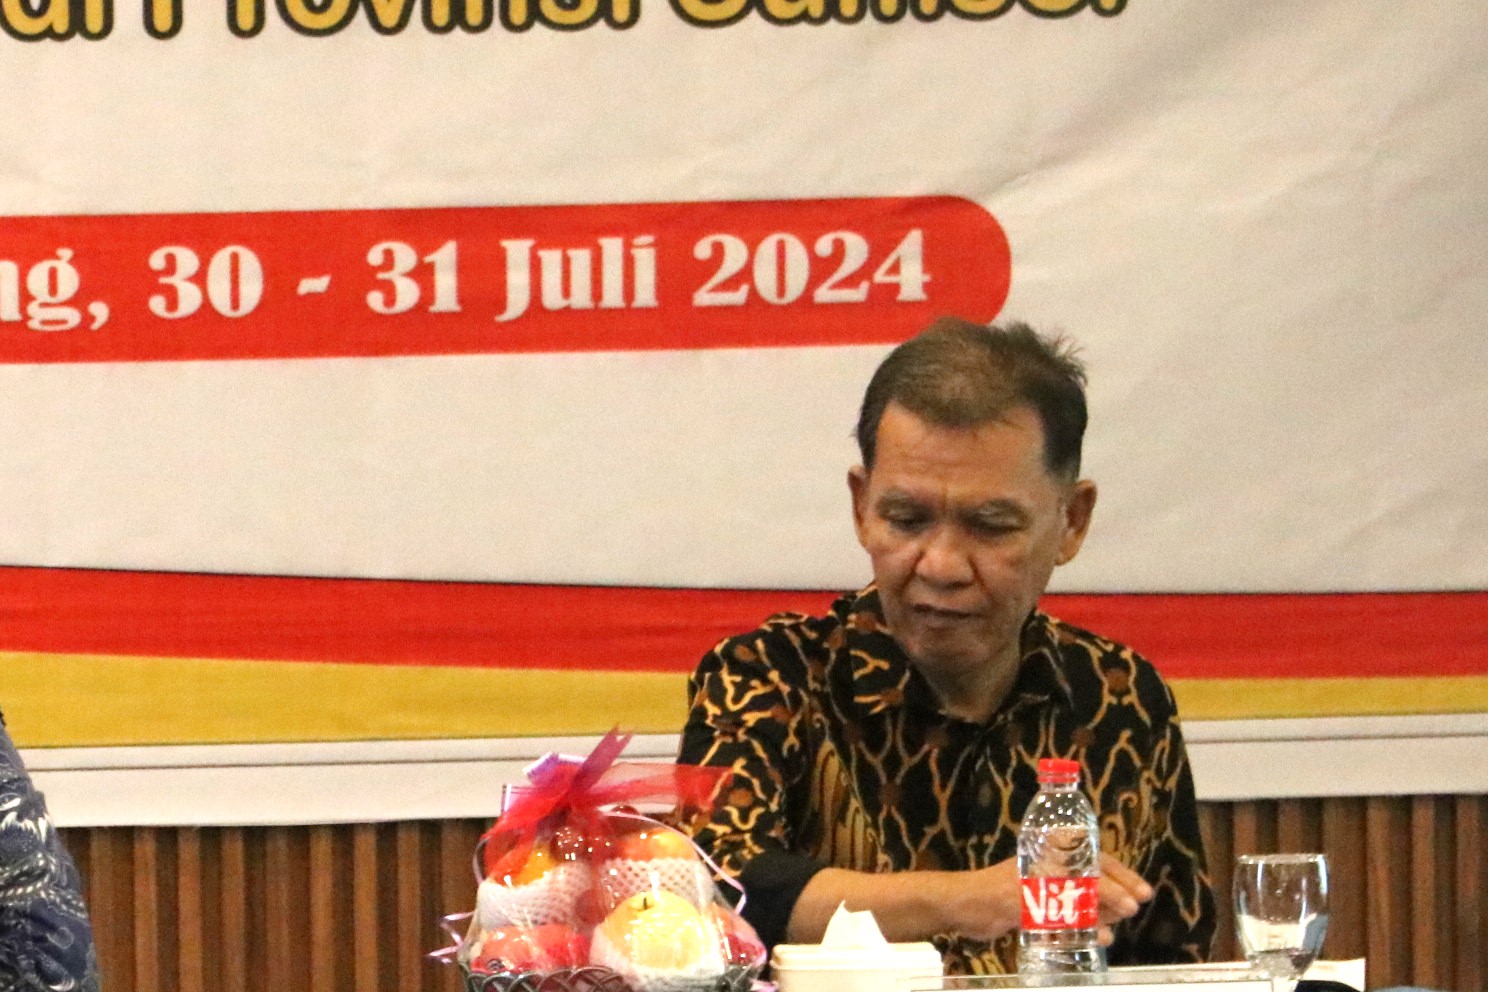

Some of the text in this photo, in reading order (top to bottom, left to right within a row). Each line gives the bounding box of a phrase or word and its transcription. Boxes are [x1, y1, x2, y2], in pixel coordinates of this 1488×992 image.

[148, 244, 264, 319] 30
[297, 275, 331, 296] -
[366, 240, 461, 314] 31
[495, 234, 659, 322] Juli
[693, 229, 932, 307] 2024
